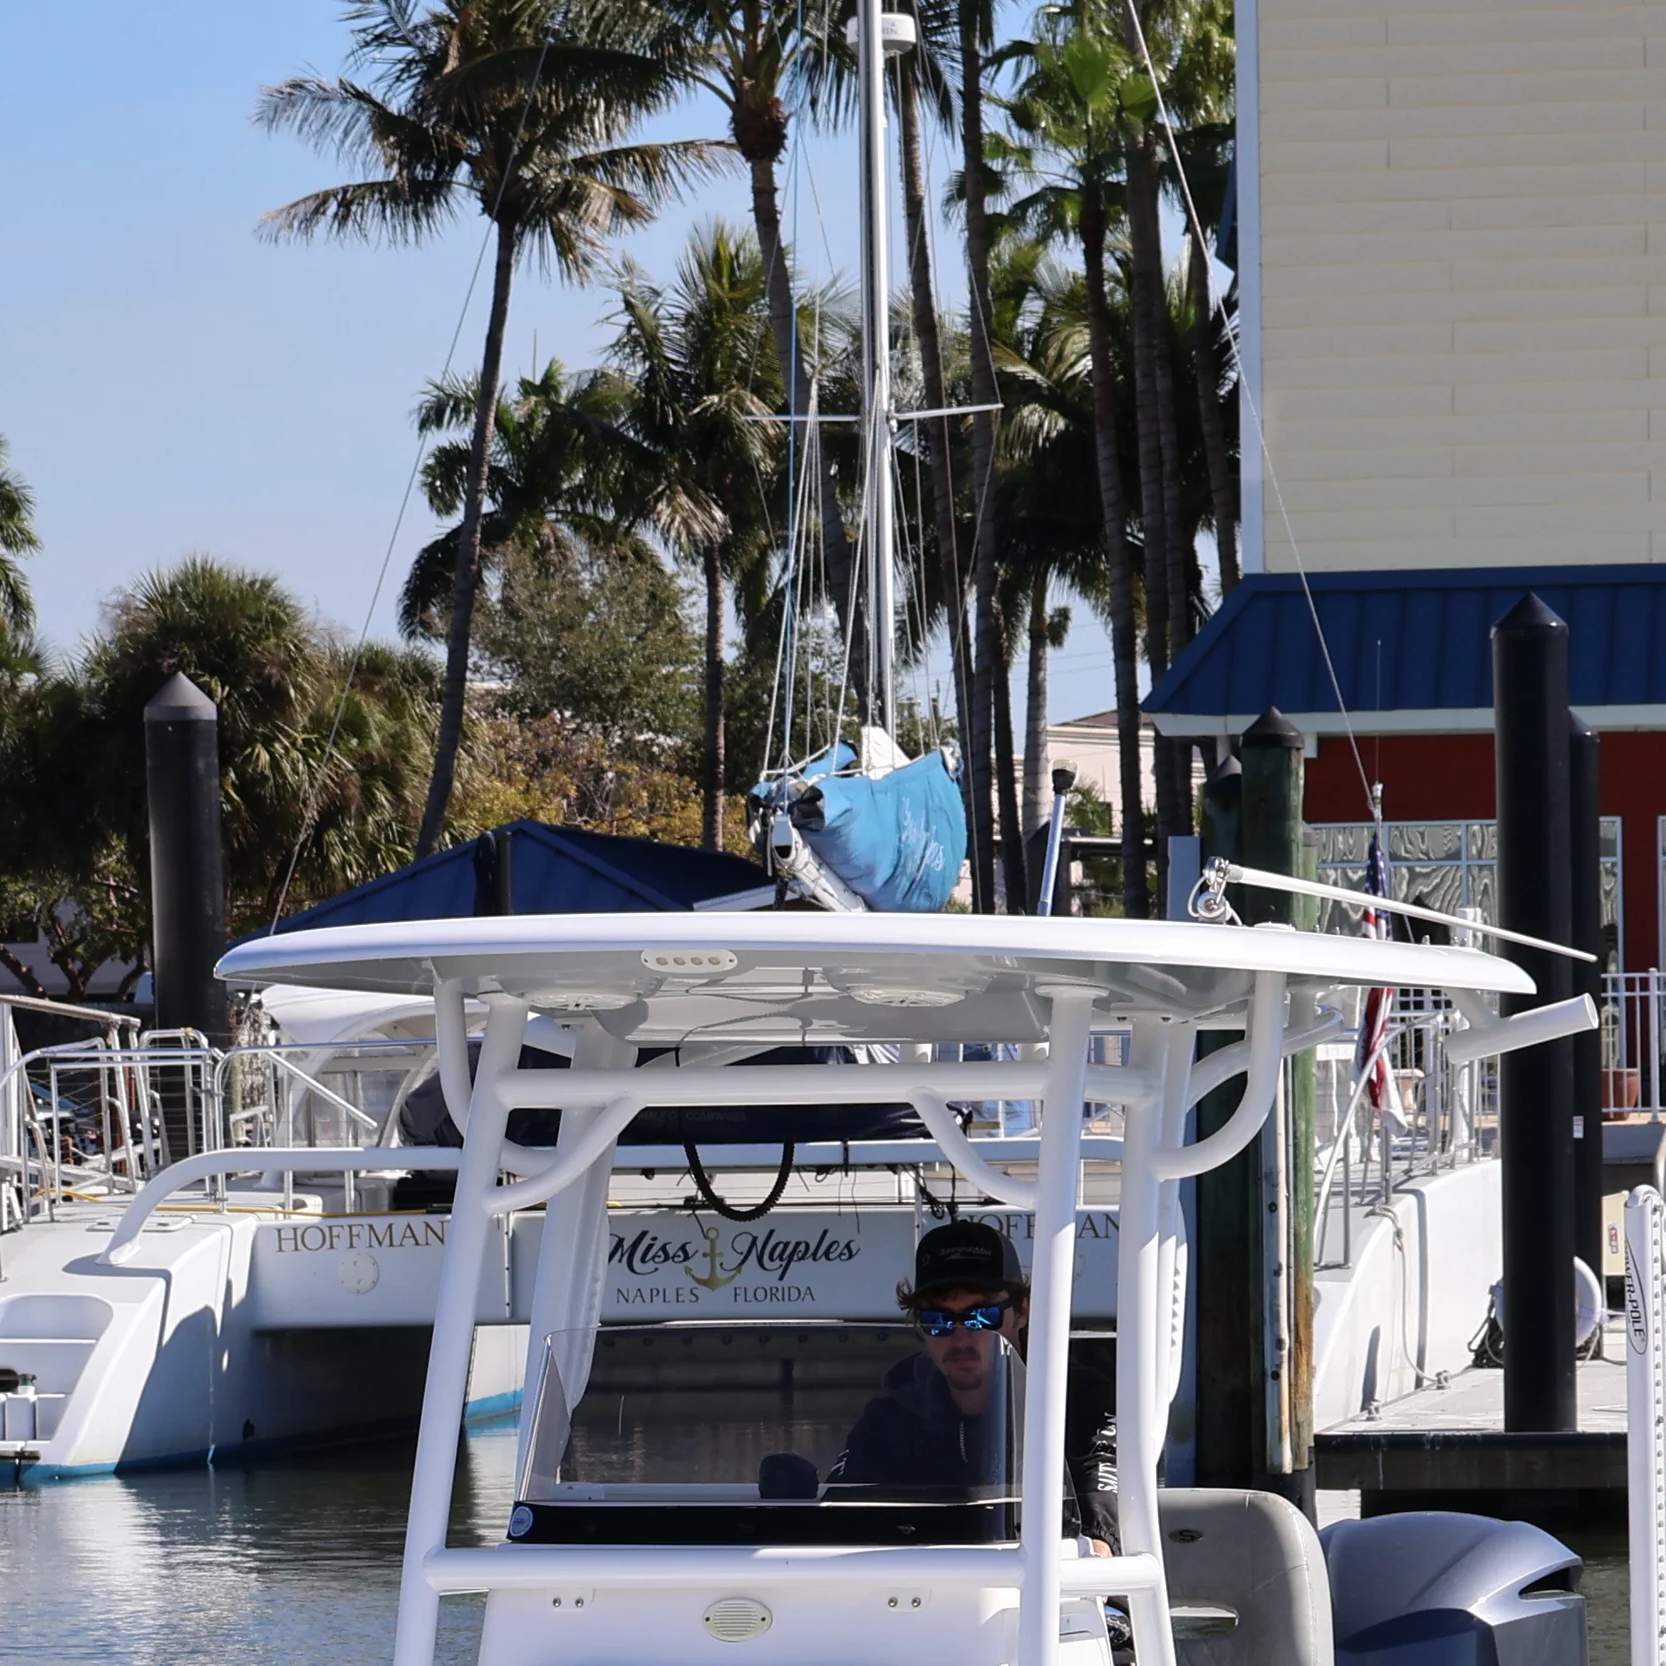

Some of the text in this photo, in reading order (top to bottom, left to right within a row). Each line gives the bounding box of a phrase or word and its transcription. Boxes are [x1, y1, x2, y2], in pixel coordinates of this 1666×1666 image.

[608, 1228, 861, 1281] Miss Naples
[616, 1285, 816, 1305] NAPLES FLORIDA
